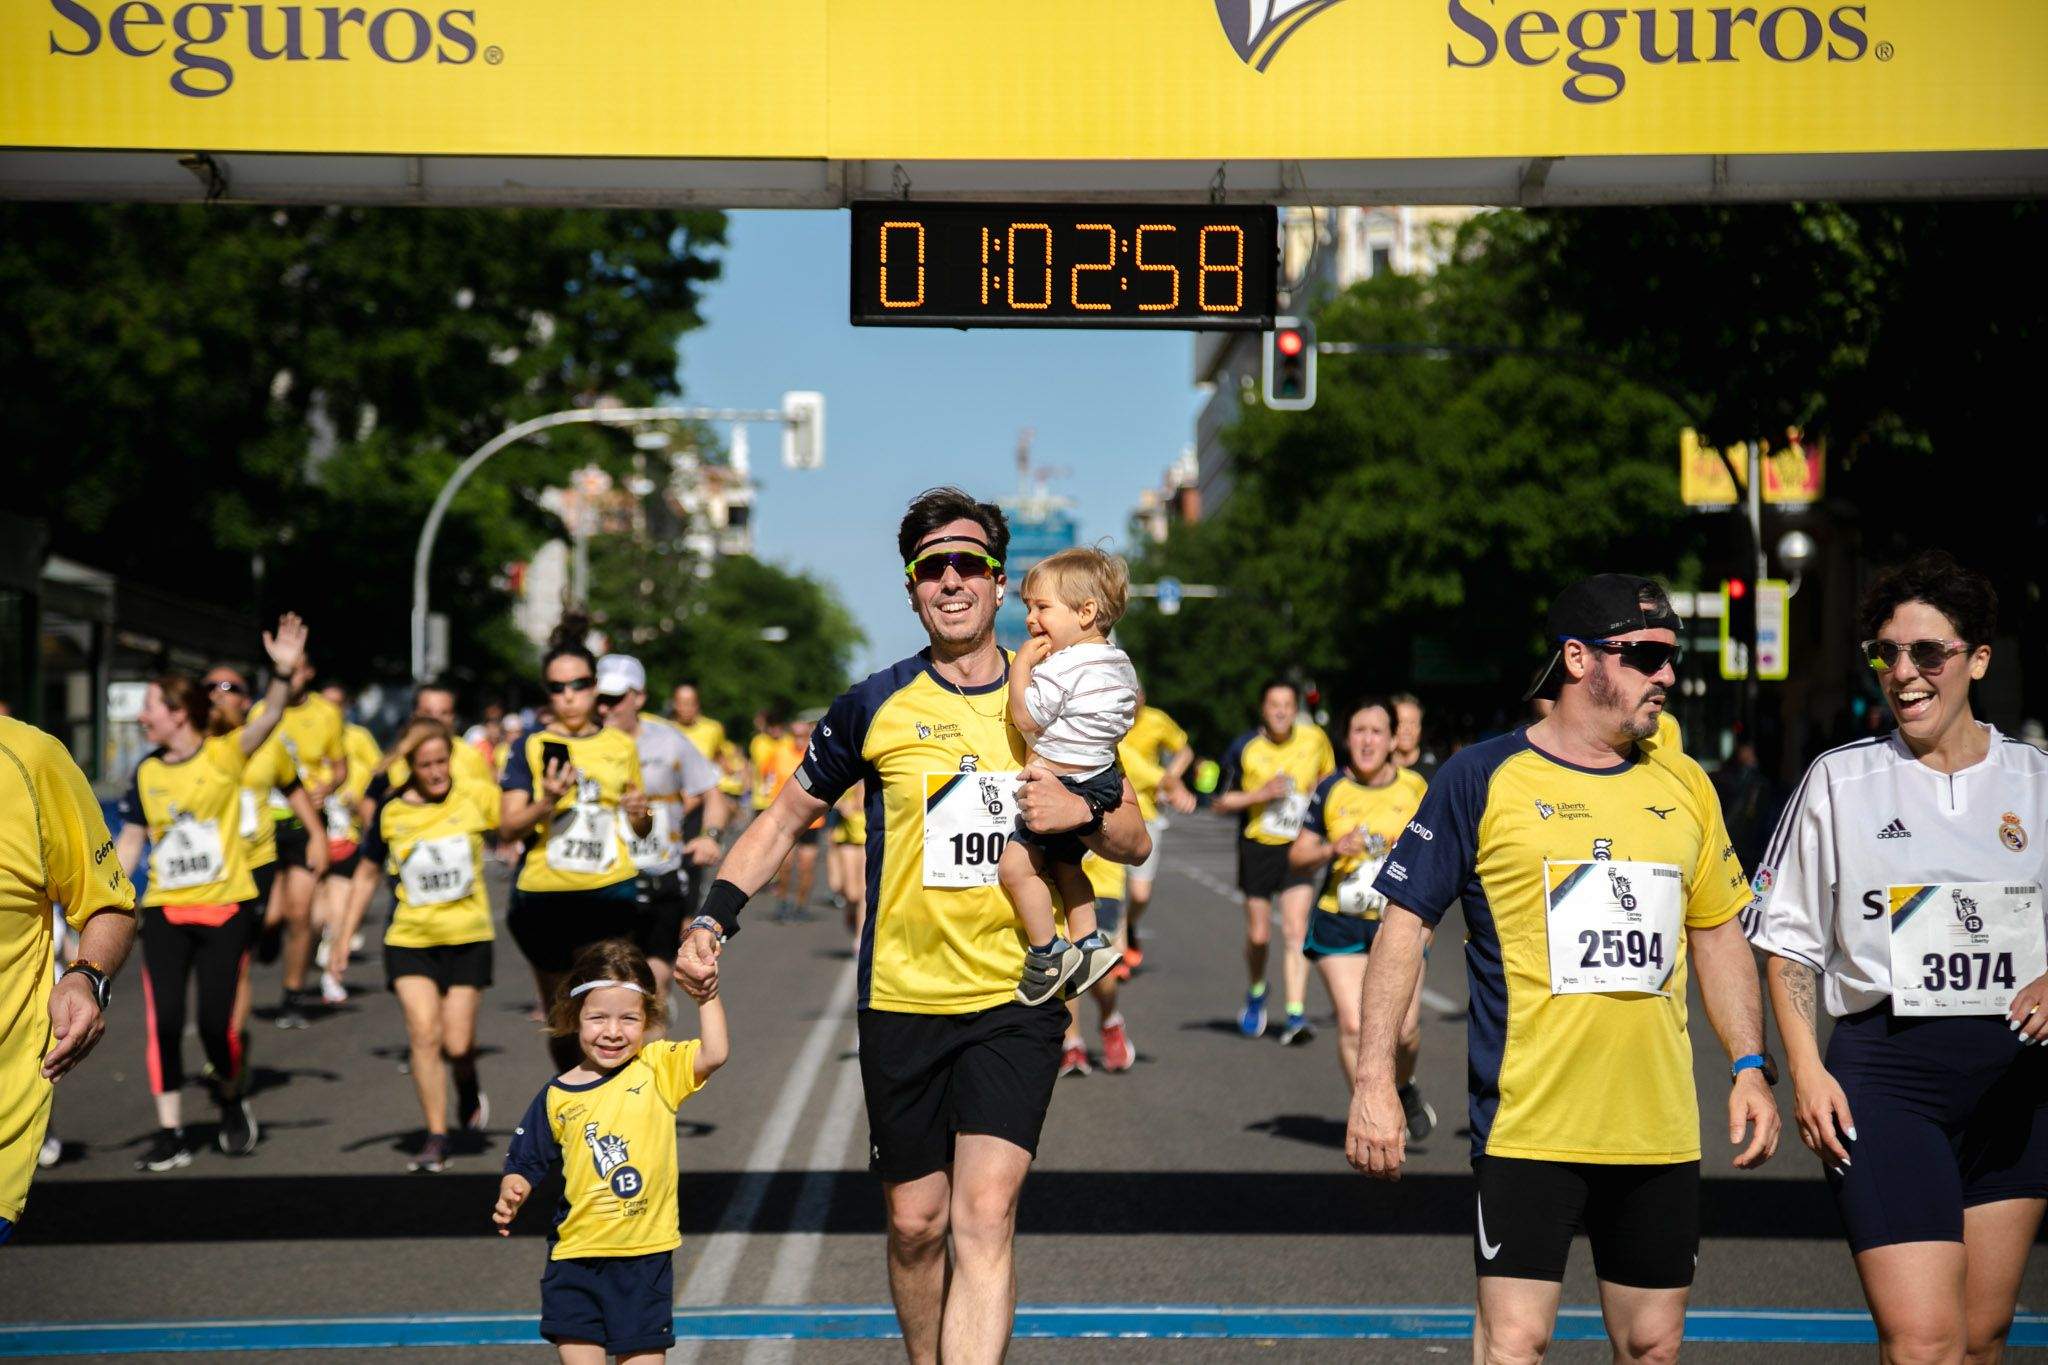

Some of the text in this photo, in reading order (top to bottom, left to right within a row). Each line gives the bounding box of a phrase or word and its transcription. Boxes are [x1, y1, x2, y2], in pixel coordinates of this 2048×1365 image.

[949, 832, 1006, 866] 190
[1877, 830, 1912, 839] adidas
[1578, 930, 1663, 970] 2594
[1922, 952, 2017, 992] 3974
[615, 1172, 638, 1193] 13
